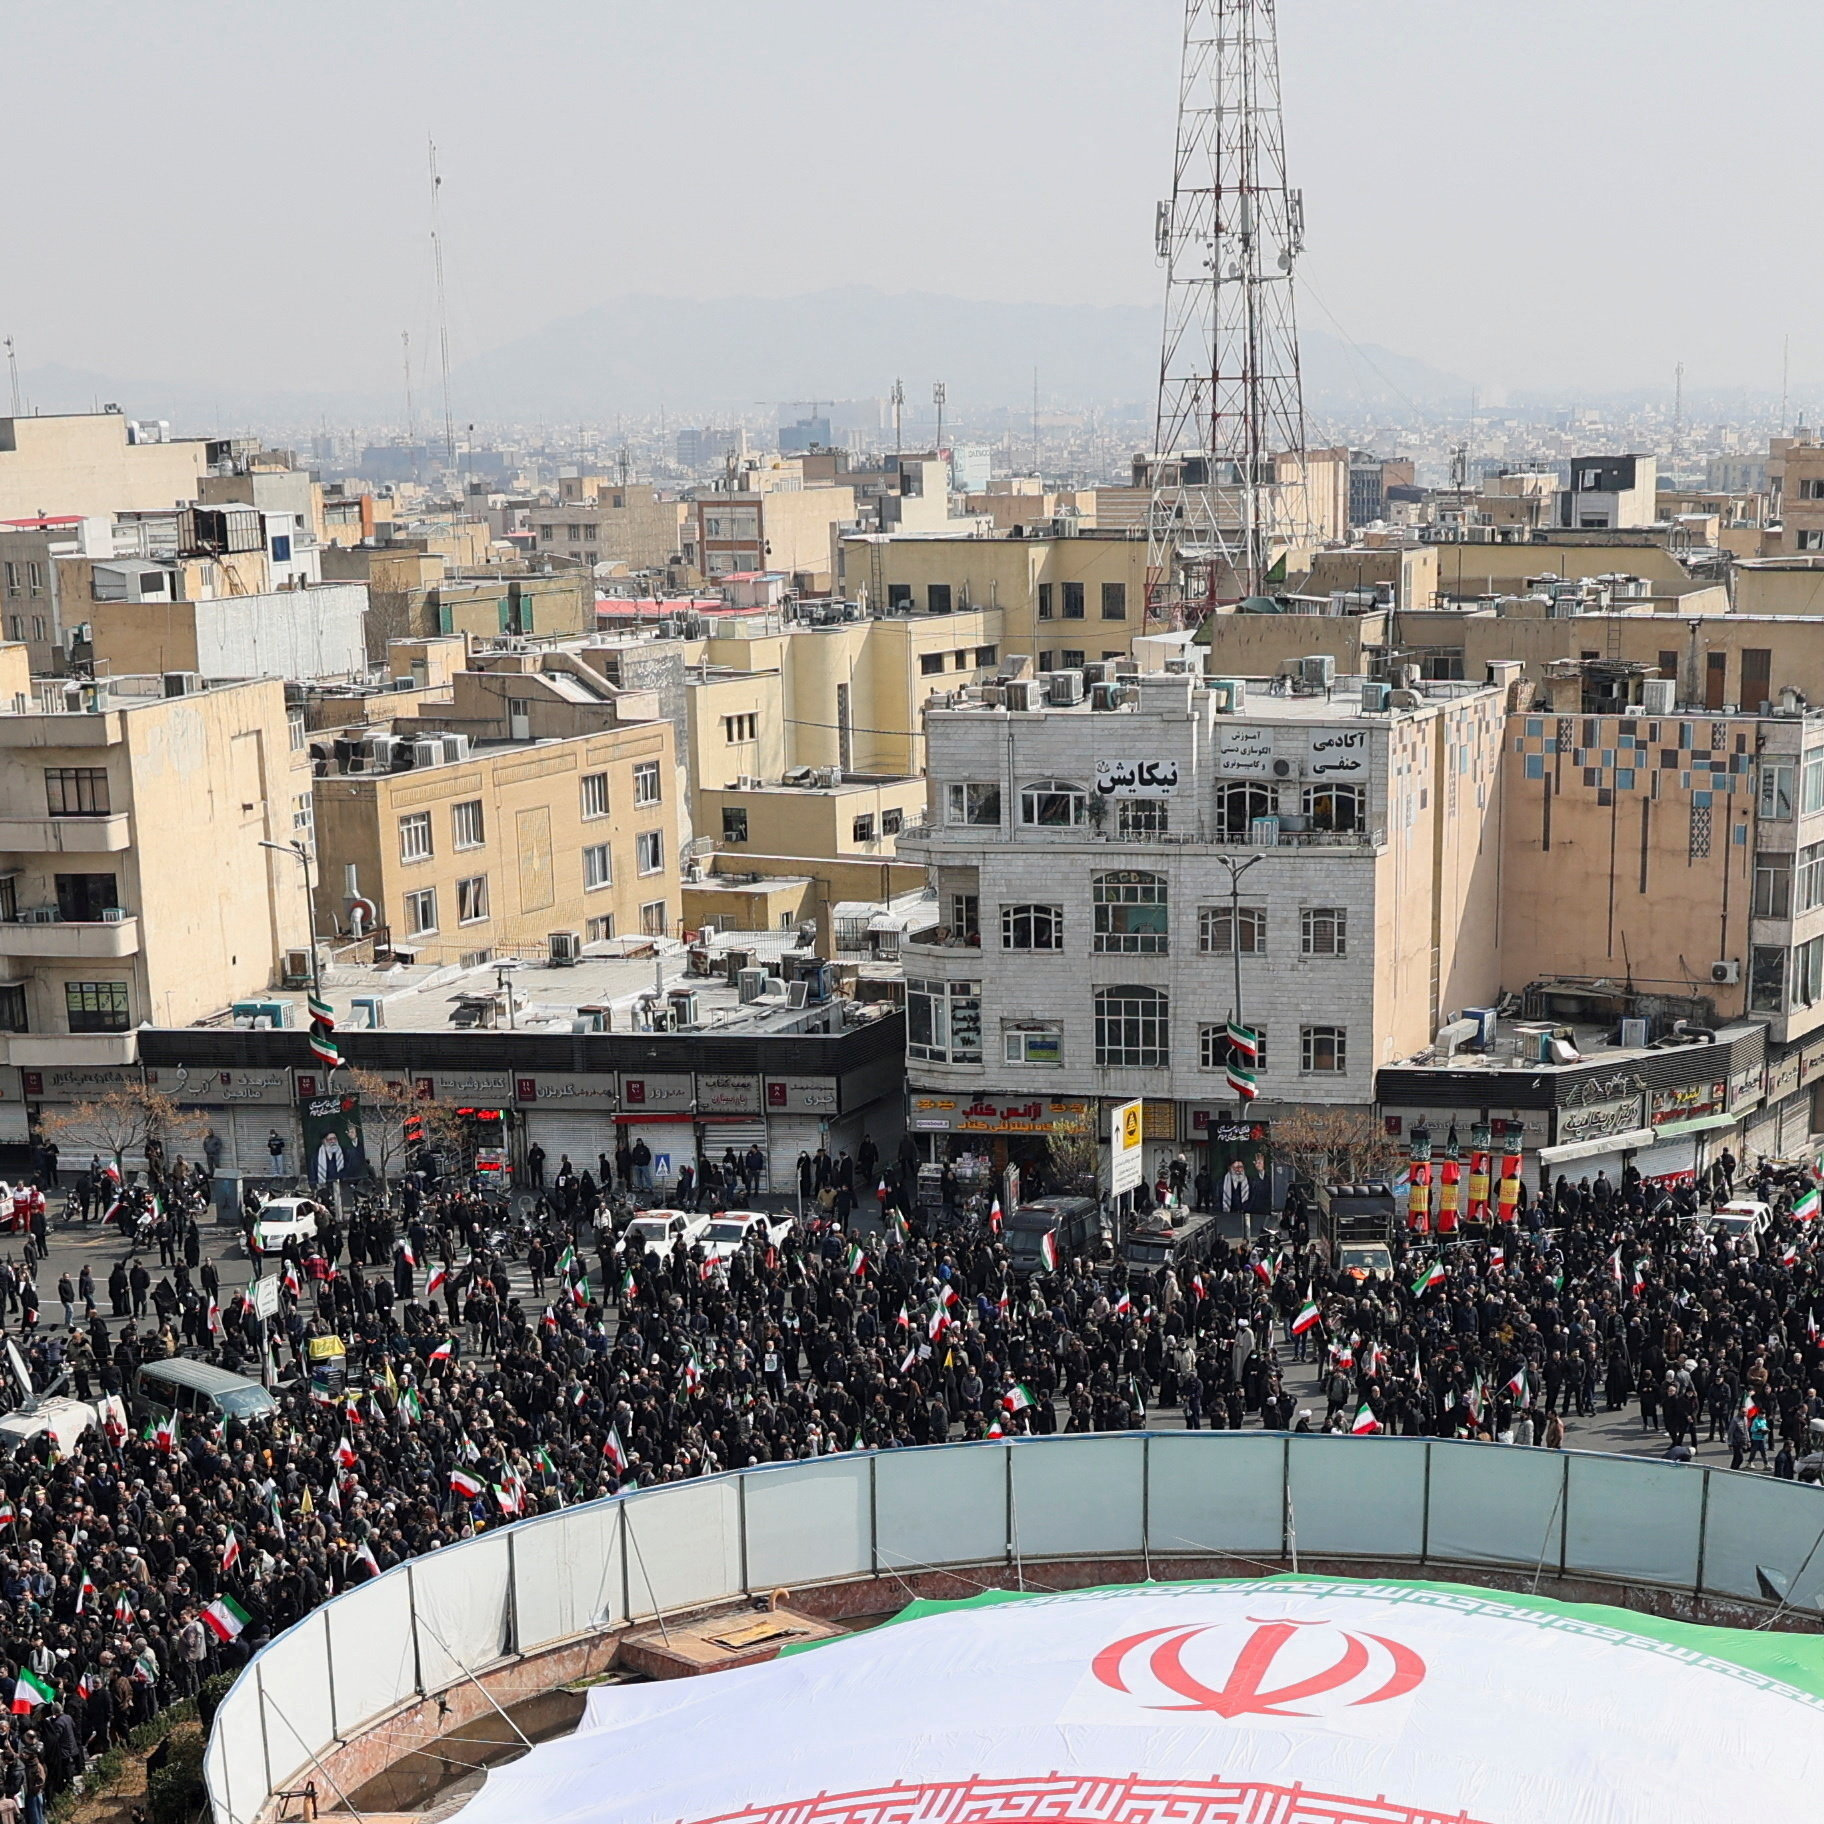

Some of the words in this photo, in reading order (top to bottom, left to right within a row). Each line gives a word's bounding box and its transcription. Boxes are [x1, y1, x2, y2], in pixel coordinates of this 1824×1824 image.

[1313, 731, 1367, 751] آکادمی
[1313, 756, 1362, 774] حنفی
[1097, 761, 1178, 794] نیکایش
[962, 1103, 997, 1119] کتاب
